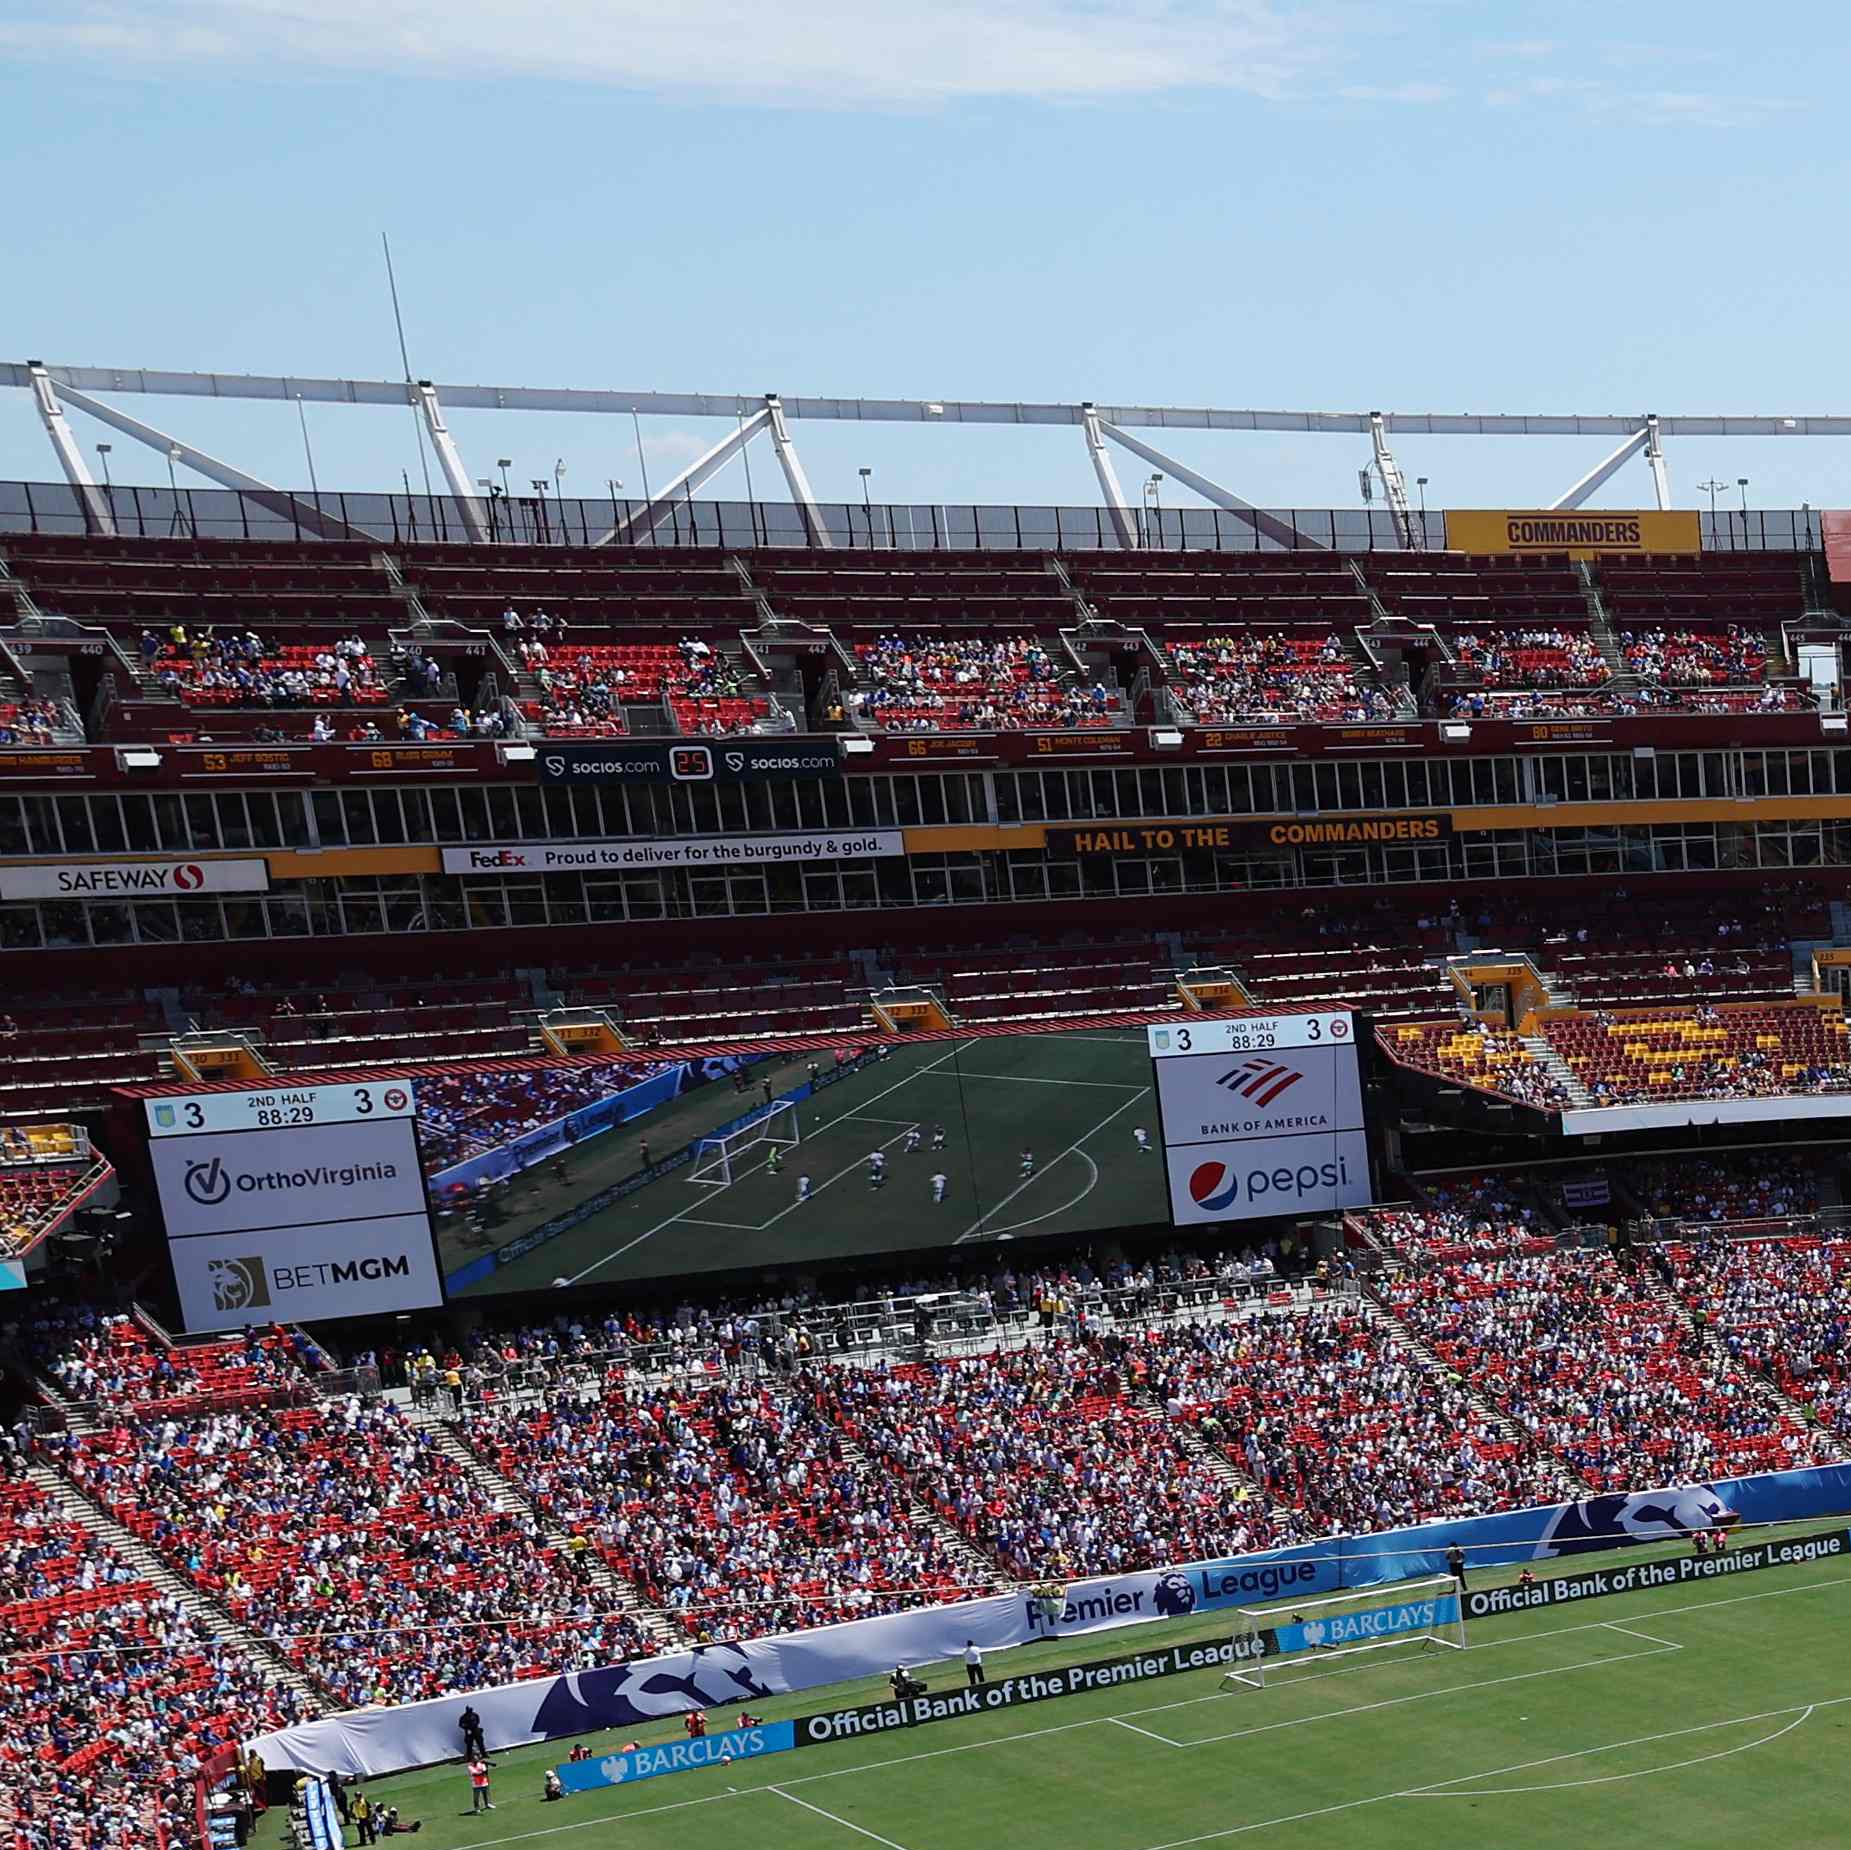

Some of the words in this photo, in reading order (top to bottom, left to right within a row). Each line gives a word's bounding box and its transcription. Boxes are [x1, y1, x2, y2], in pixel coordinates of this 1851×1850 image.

[1507, 521, 1641, 544] COMMANDERS
[80, 644, 103, 656] 440
[466, 646, 486, 657] 441
[808, 643, 826, 655] 442
[907, 739, 928, 755] 66
[203, 753, 227, 771] 53
[572, 757, 661, 777] socios.com
[677, 753, 705, 773] 25
[750, 754, 836, 773] socios.com
[1074, 831, 1136, 852] HAIL
[1140, 829, 1176, 849] TO
[1181, 827, 1231, 849] THE
[1268, 819, 1441, 846] COMMANDERS
[469, 850, 526, 868] FedEx
[545, 851, 598, 865] Proud
[600, 850, 620, 864] to
[623, 846, 681, 864] deliver
[684, 844, 711, 860] for
[712, 844, 740, 859] the
[743, 838, 823, 861] burgundy
[826, 839, 839, 855] &
[842, 836, 883, 855] gold.
[58, 868, 169, 892] SAFEWAY
[1225, 1022, 1247, 1035] 2ND
[1251, 1020, 1280, 1034] HALF
[1307, 1018, 1322, 1041] 3
[1176, 1028, 1193, 1051] 3
[1231, 1033, 1276, 1050] 88:29
[247, 1096, 277, 1110] 2ND
[281, 1092, 318, 1108] HALF
[354, 1088, 373, 1114] 3
[184, 1102, 206, 1129] 3
[257, 1106, 315, 1127] 88:29
[1201, 1121, 1241, 1136] BANK
[1243, 1119, 1262, 1133] OF
[1264, 1114, 1328, 1131] AMERICA
[236, 1160, 398, 1193] OrthoVirginia
[1247, 1156, 1348, 1203] pepsi
[272, 1254, 410, 1291] BETMGM
[1202, 1562, 1317, 1600] League
[1469, 1585, 1551, 1615] Official
[1554, 1573, 1610, 1602] Bank
[1611, 1568, 1640, 1591] of
[1640, 1562, 1677, 1587] the
[1679, 1545, 1763, 1580] Premier
[1766, 1536, 1841, 1570] League
[1330, 1601, 1435, 1640] BARCLAYS
[807, 1707, 909, 1741] Official
[913, 1690, 981, 1722] Bank
[985, 1683, 1015, 1706] of
[1016, 1675, 1064, 1701] the
[1069, 1652, 1169, 1690] Premier
[1173, 1636, 1266, 1671] League
[635, 1728, 766, 1776] BARCLAYS
